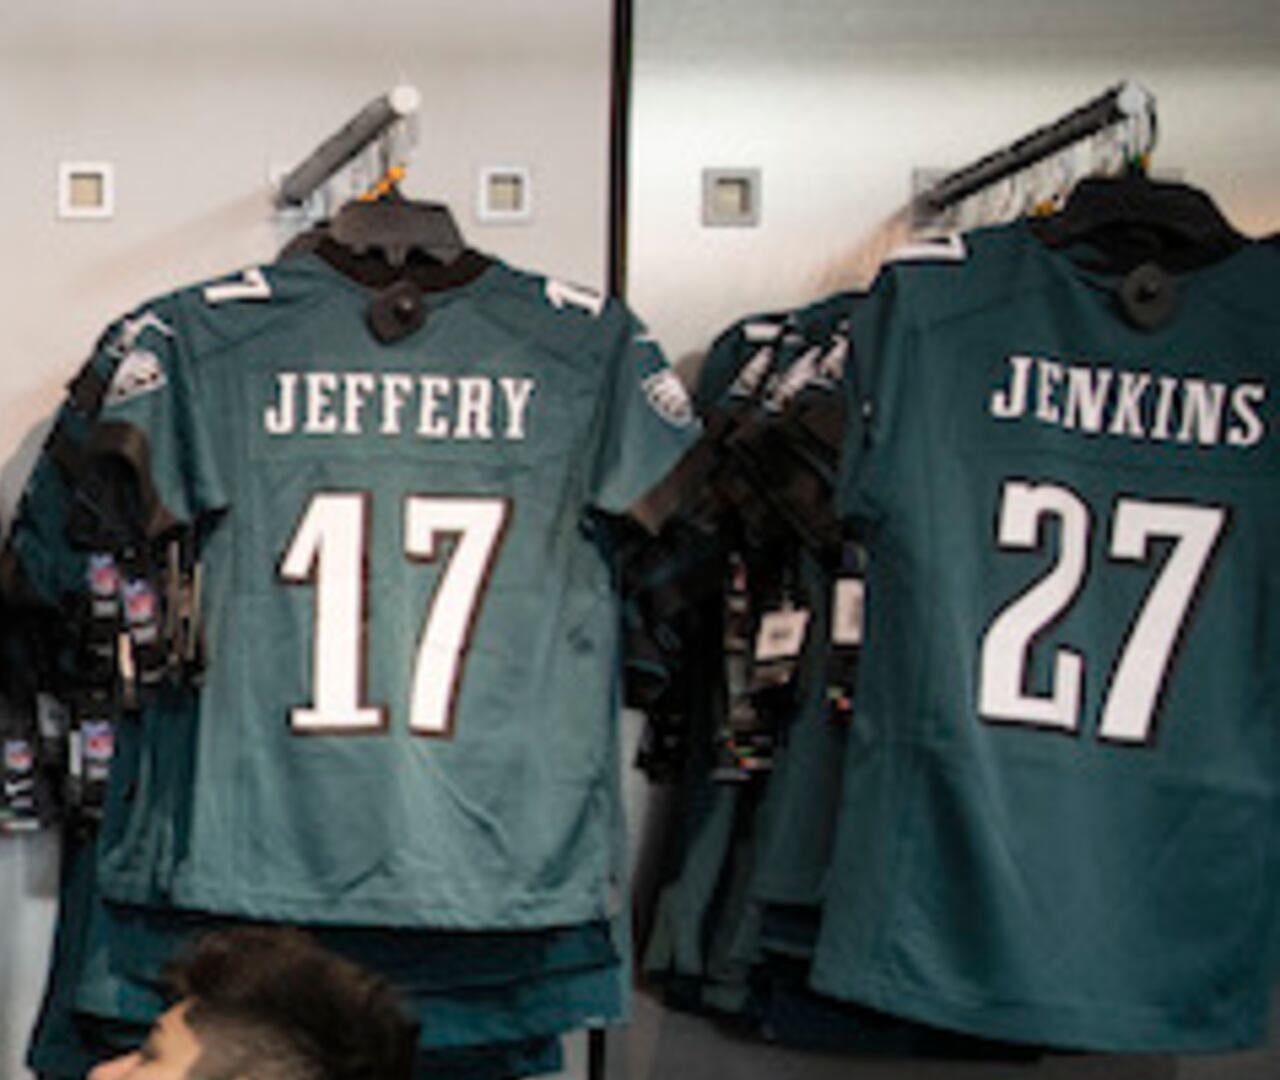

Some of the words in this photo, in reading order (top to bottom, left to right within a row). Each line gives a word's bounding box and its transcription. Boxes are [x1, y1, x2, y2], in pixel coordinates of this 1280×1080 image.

[263, 371, 534, 441] JEFFERY
[989, 355, 1265, 448] JENKINS
[280, 492, 508, 736] 17
[977, 480, 1229, 744] 27
